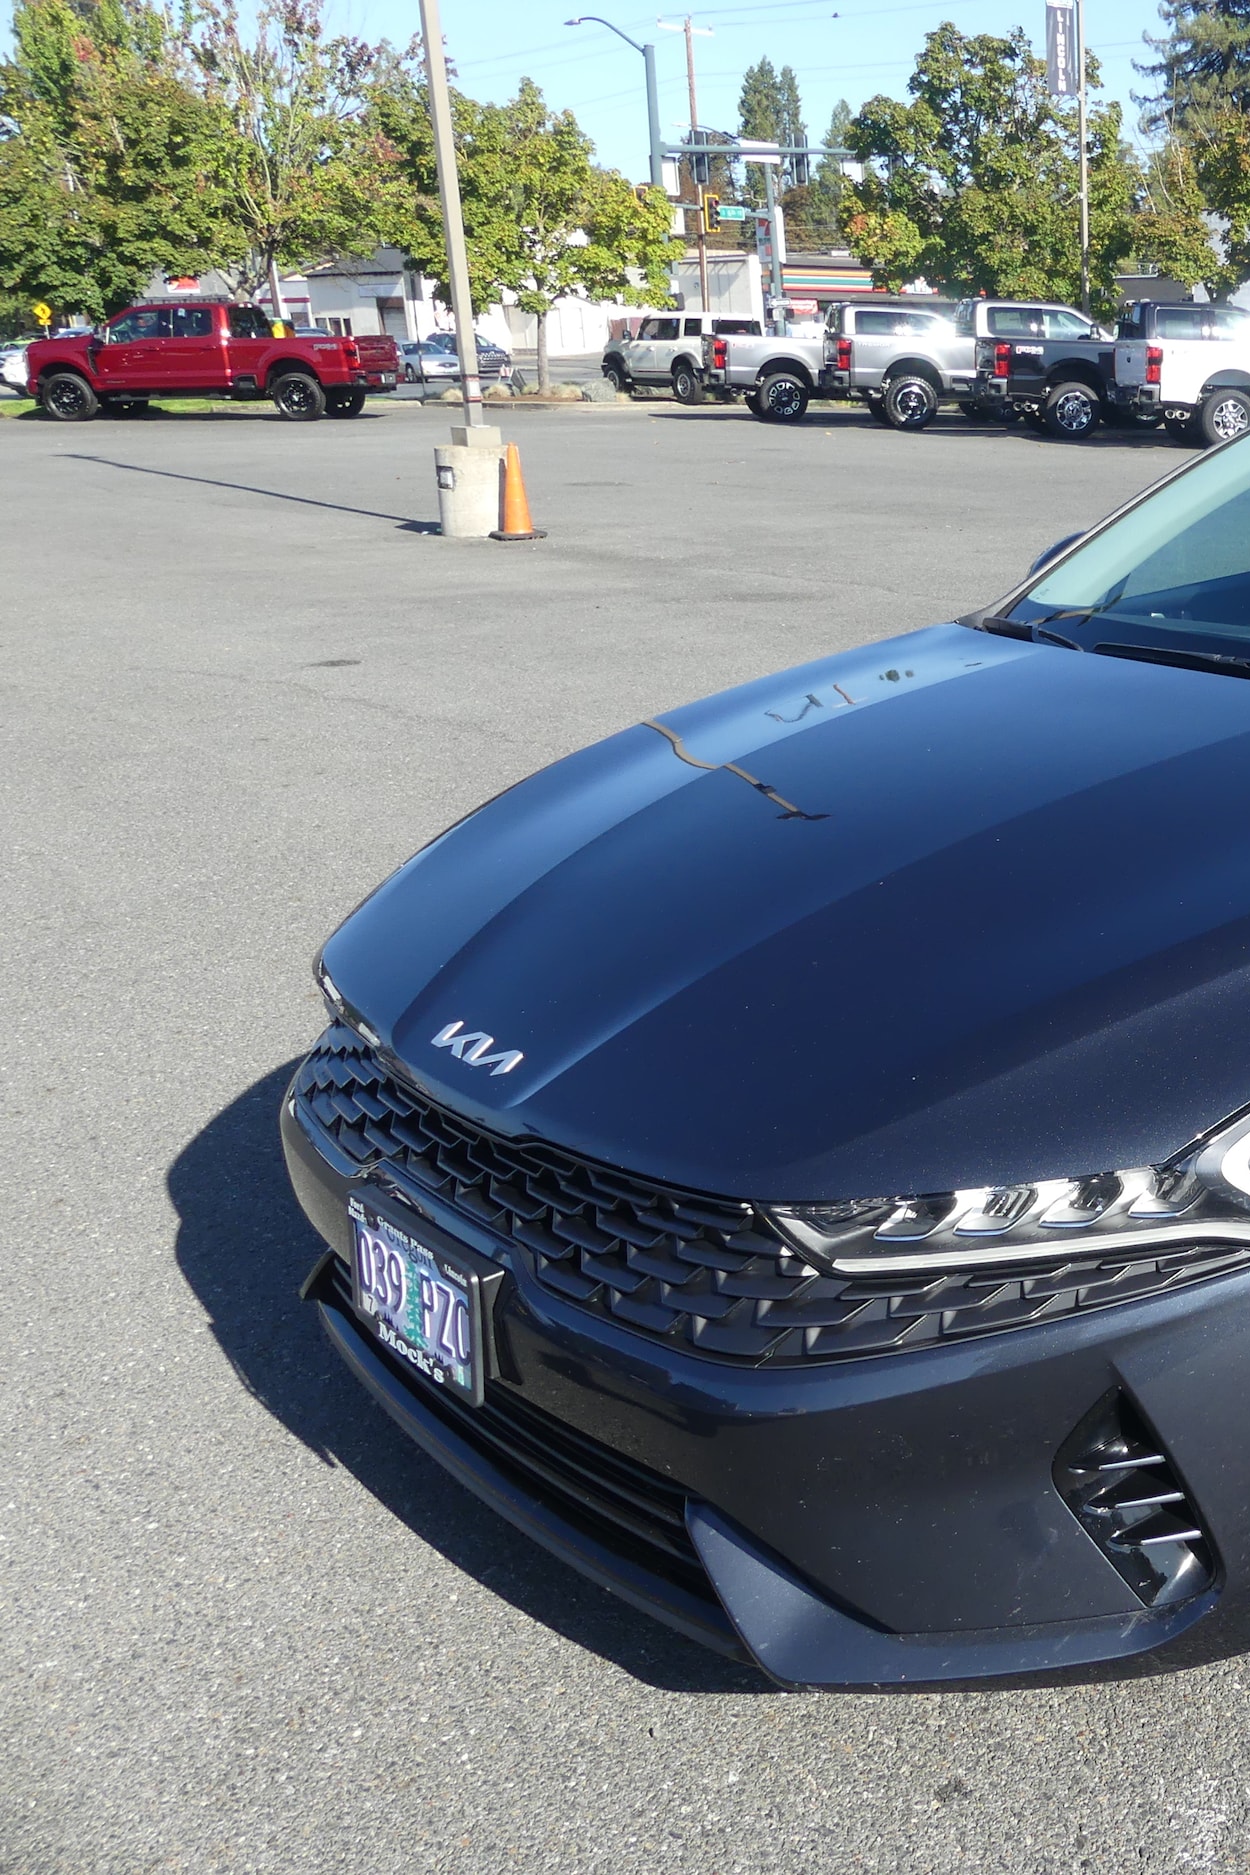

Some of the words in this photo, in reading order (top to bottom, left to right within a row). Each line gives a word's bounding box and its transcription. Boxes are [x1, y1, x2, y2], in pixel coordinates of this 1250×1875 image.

[1056, 9, 1067, 92] LINCOLN
[359, 1229, 406, 1313] 039
[410, 1237, 435, 1260] Pass
[378, 1320, 445, 1384] Mock's
